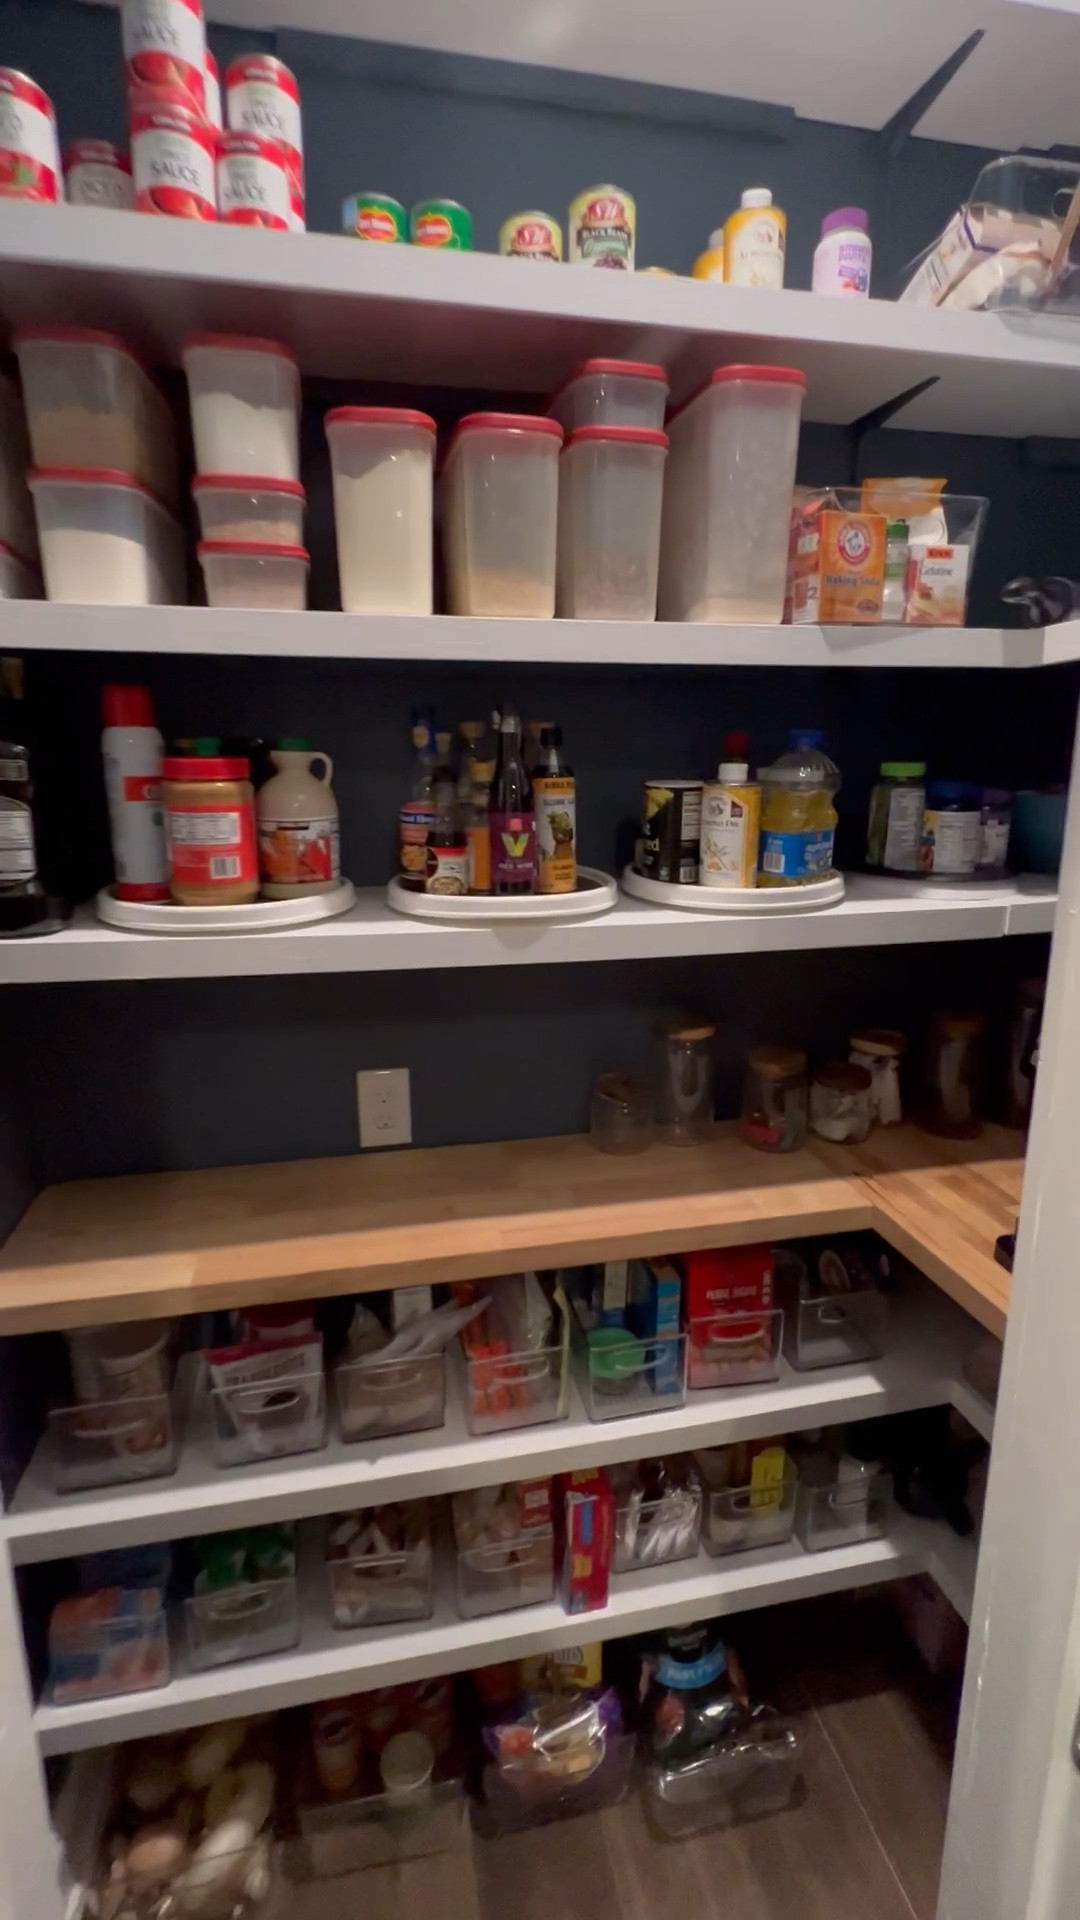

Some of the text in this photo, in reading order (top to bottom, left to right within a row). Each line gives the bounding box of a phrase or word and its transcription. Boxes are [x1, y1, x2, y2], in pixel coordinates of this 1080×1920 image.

[150, 159, 200, 187] SAUCE
[583, 226, 606, 237] BLACK
[826, 574, 857, 588] Baking
